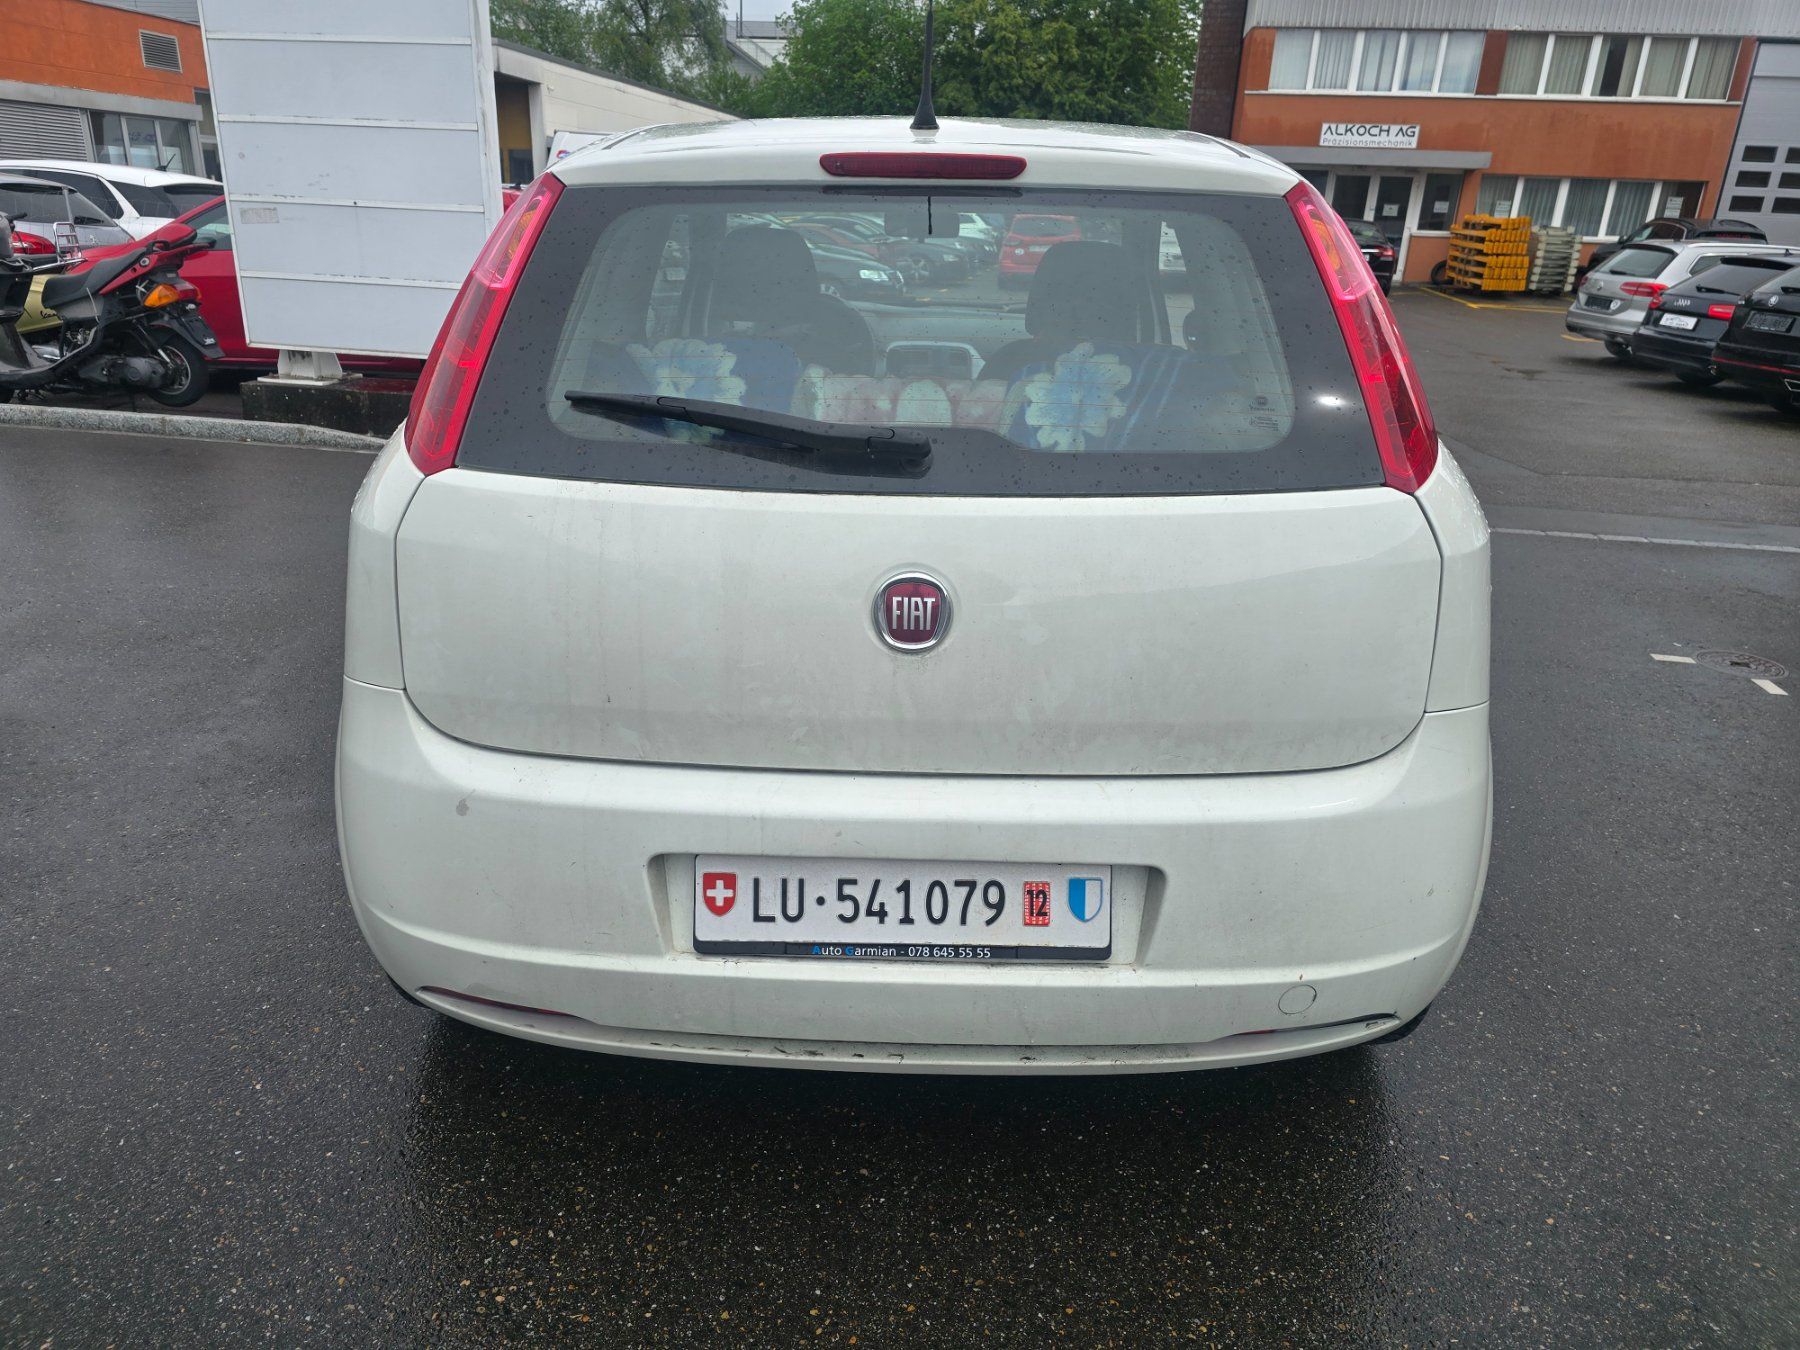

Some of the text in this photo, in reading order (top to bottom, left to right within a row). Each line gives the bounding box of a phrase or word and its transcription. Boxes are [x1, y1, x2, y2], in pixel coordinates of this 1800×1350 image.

[1323, 124, 1417, 138] ALKOCH AG
[892, 596, 936, 631] FIAT
[1026, 889, 1049, 917] 12
[812, 945, 843, 957] Auto
[845, 945, 897, 957] Garmian
[908, 946, 930, 957] 078
[933, 946, 955, 958] 645
[958, 947, 973, 958] 55
[976, 947, 991, 958] 55
